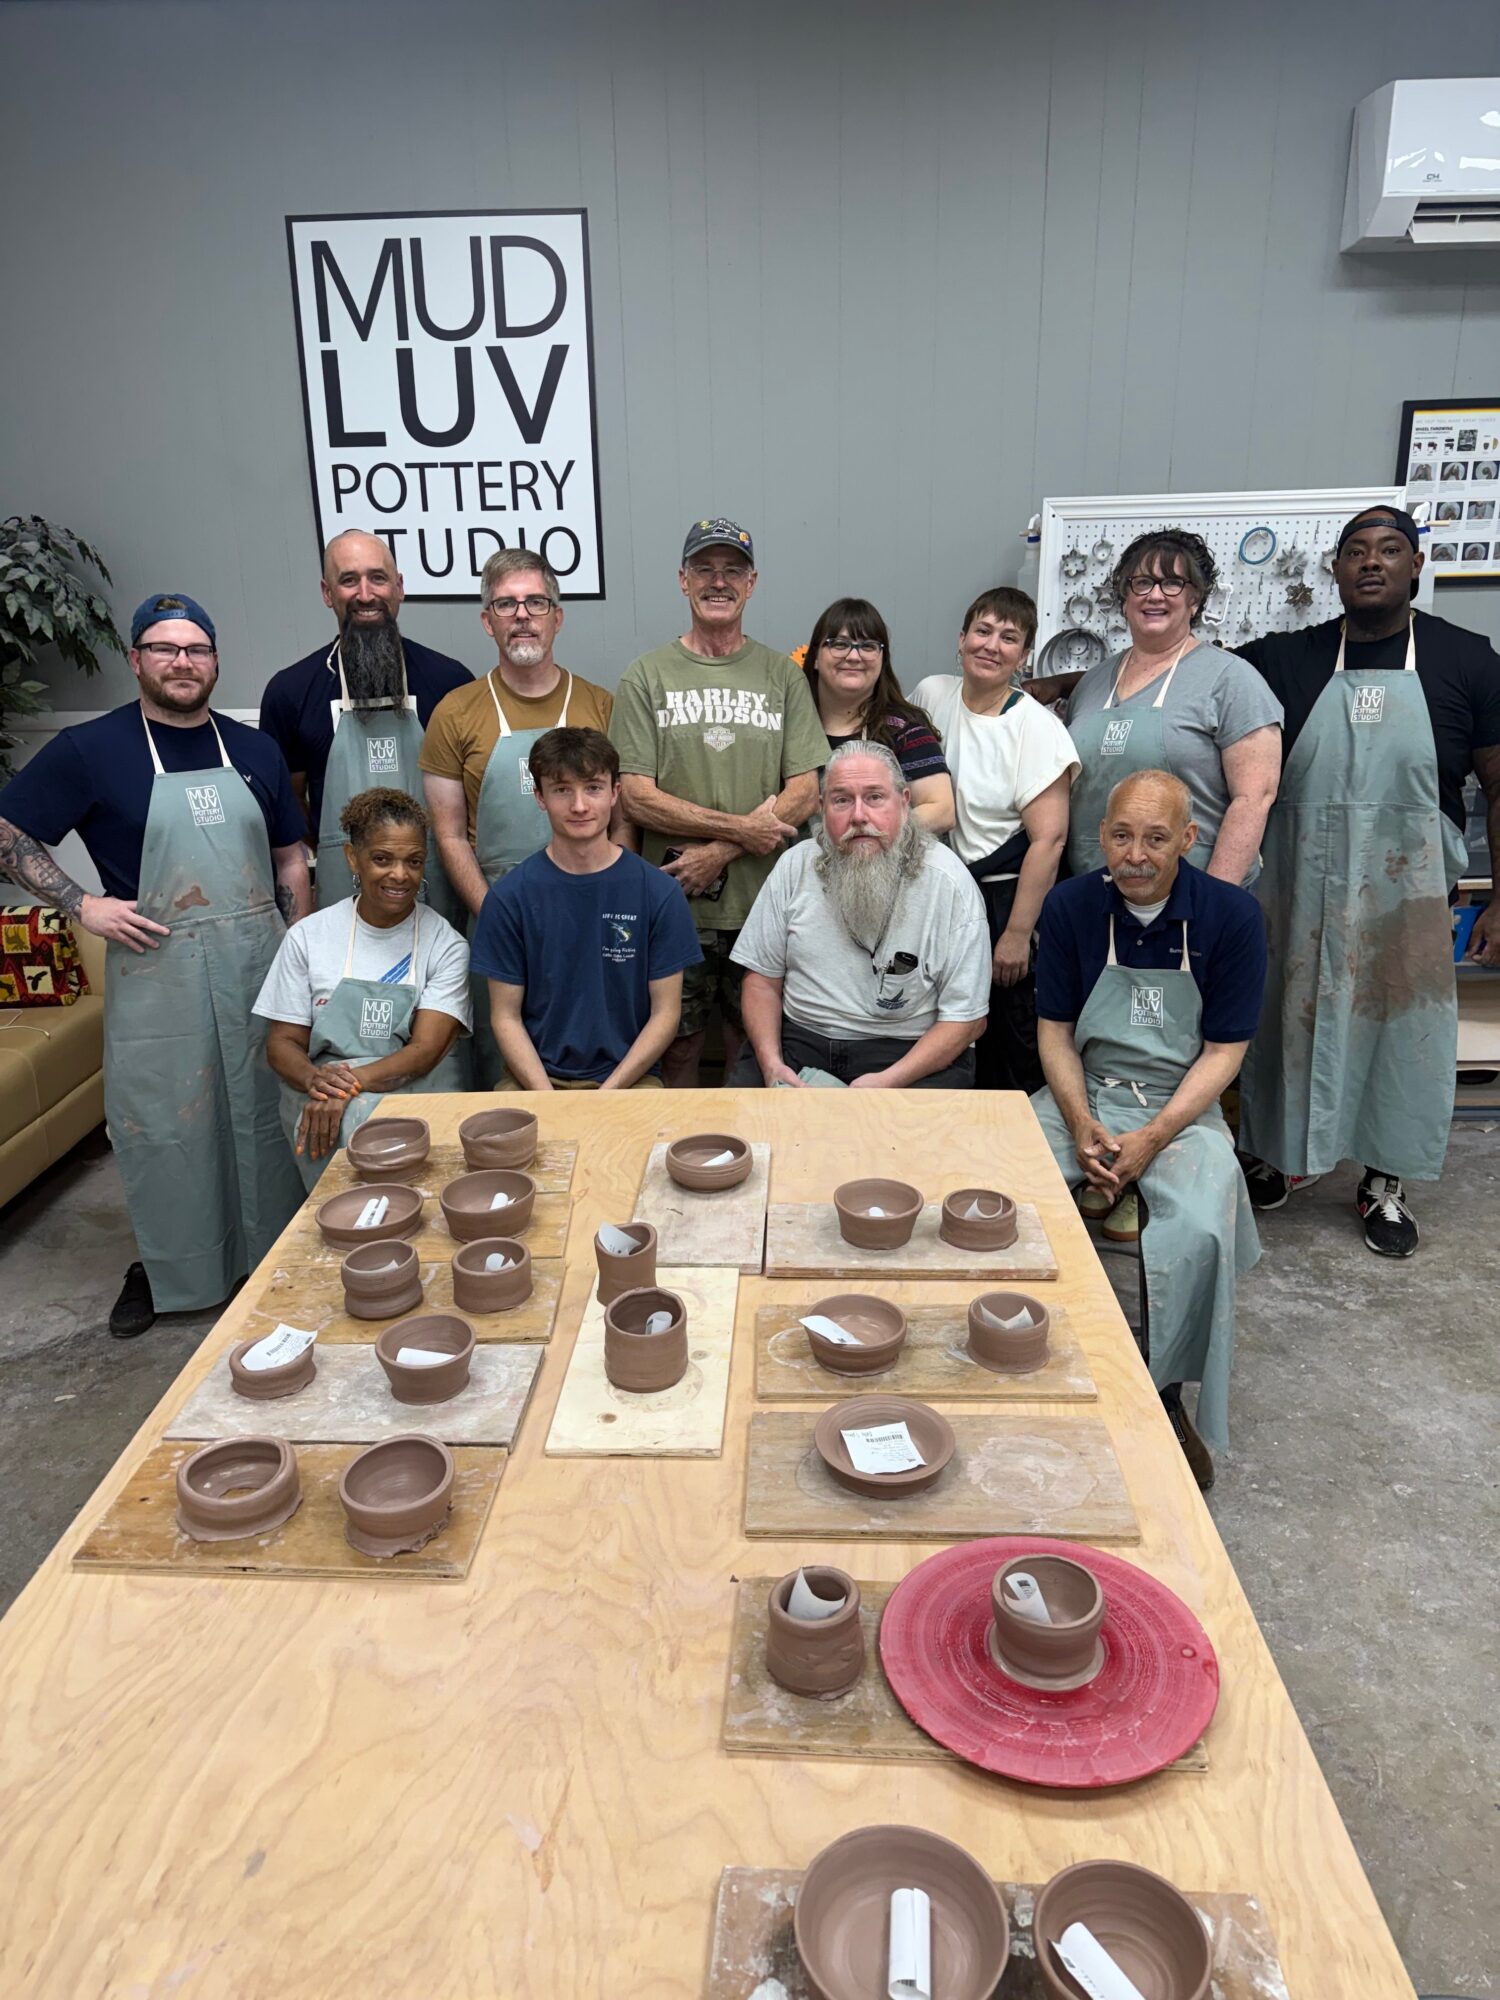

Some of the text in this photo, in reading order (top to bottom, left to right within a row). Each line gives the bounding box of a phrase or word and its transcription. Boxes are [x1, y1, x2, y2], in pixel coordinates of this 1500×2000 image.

[311, 235, 567, 342] MUD
[321, 344, 570, 447] LUV
[332, 460, 575, 513] POTTERY
[1357, 688, 1382, 698] MUD
[1356, 697, 1381, 708] LUV
[656, 705, 783, 731] DAVIDSON
[1106, 730, 1127, 740] LUV
[369, 740, 394, 749] MUD
[370, 748, 394, 759] LUV
[188, 788, 216, 800] MUD
[192, 797, 217, 810] LUV
[194, 808, 221, 816] POTTERY
[196, 814, 222, 823] STUDIO
[1134, 988, 1160, 1001] MUD
[364, 1000, 391, 1013] MUD
[1134, 999, 1160, 1012] LUV
[364, 1011, 390, 1023] LUV
[1133, 1008, 1160, 1018] POTTERY
[1133, 1016, 1160, 1025] STUDIO
[362, 1028, 389, 1036] STUDIO
